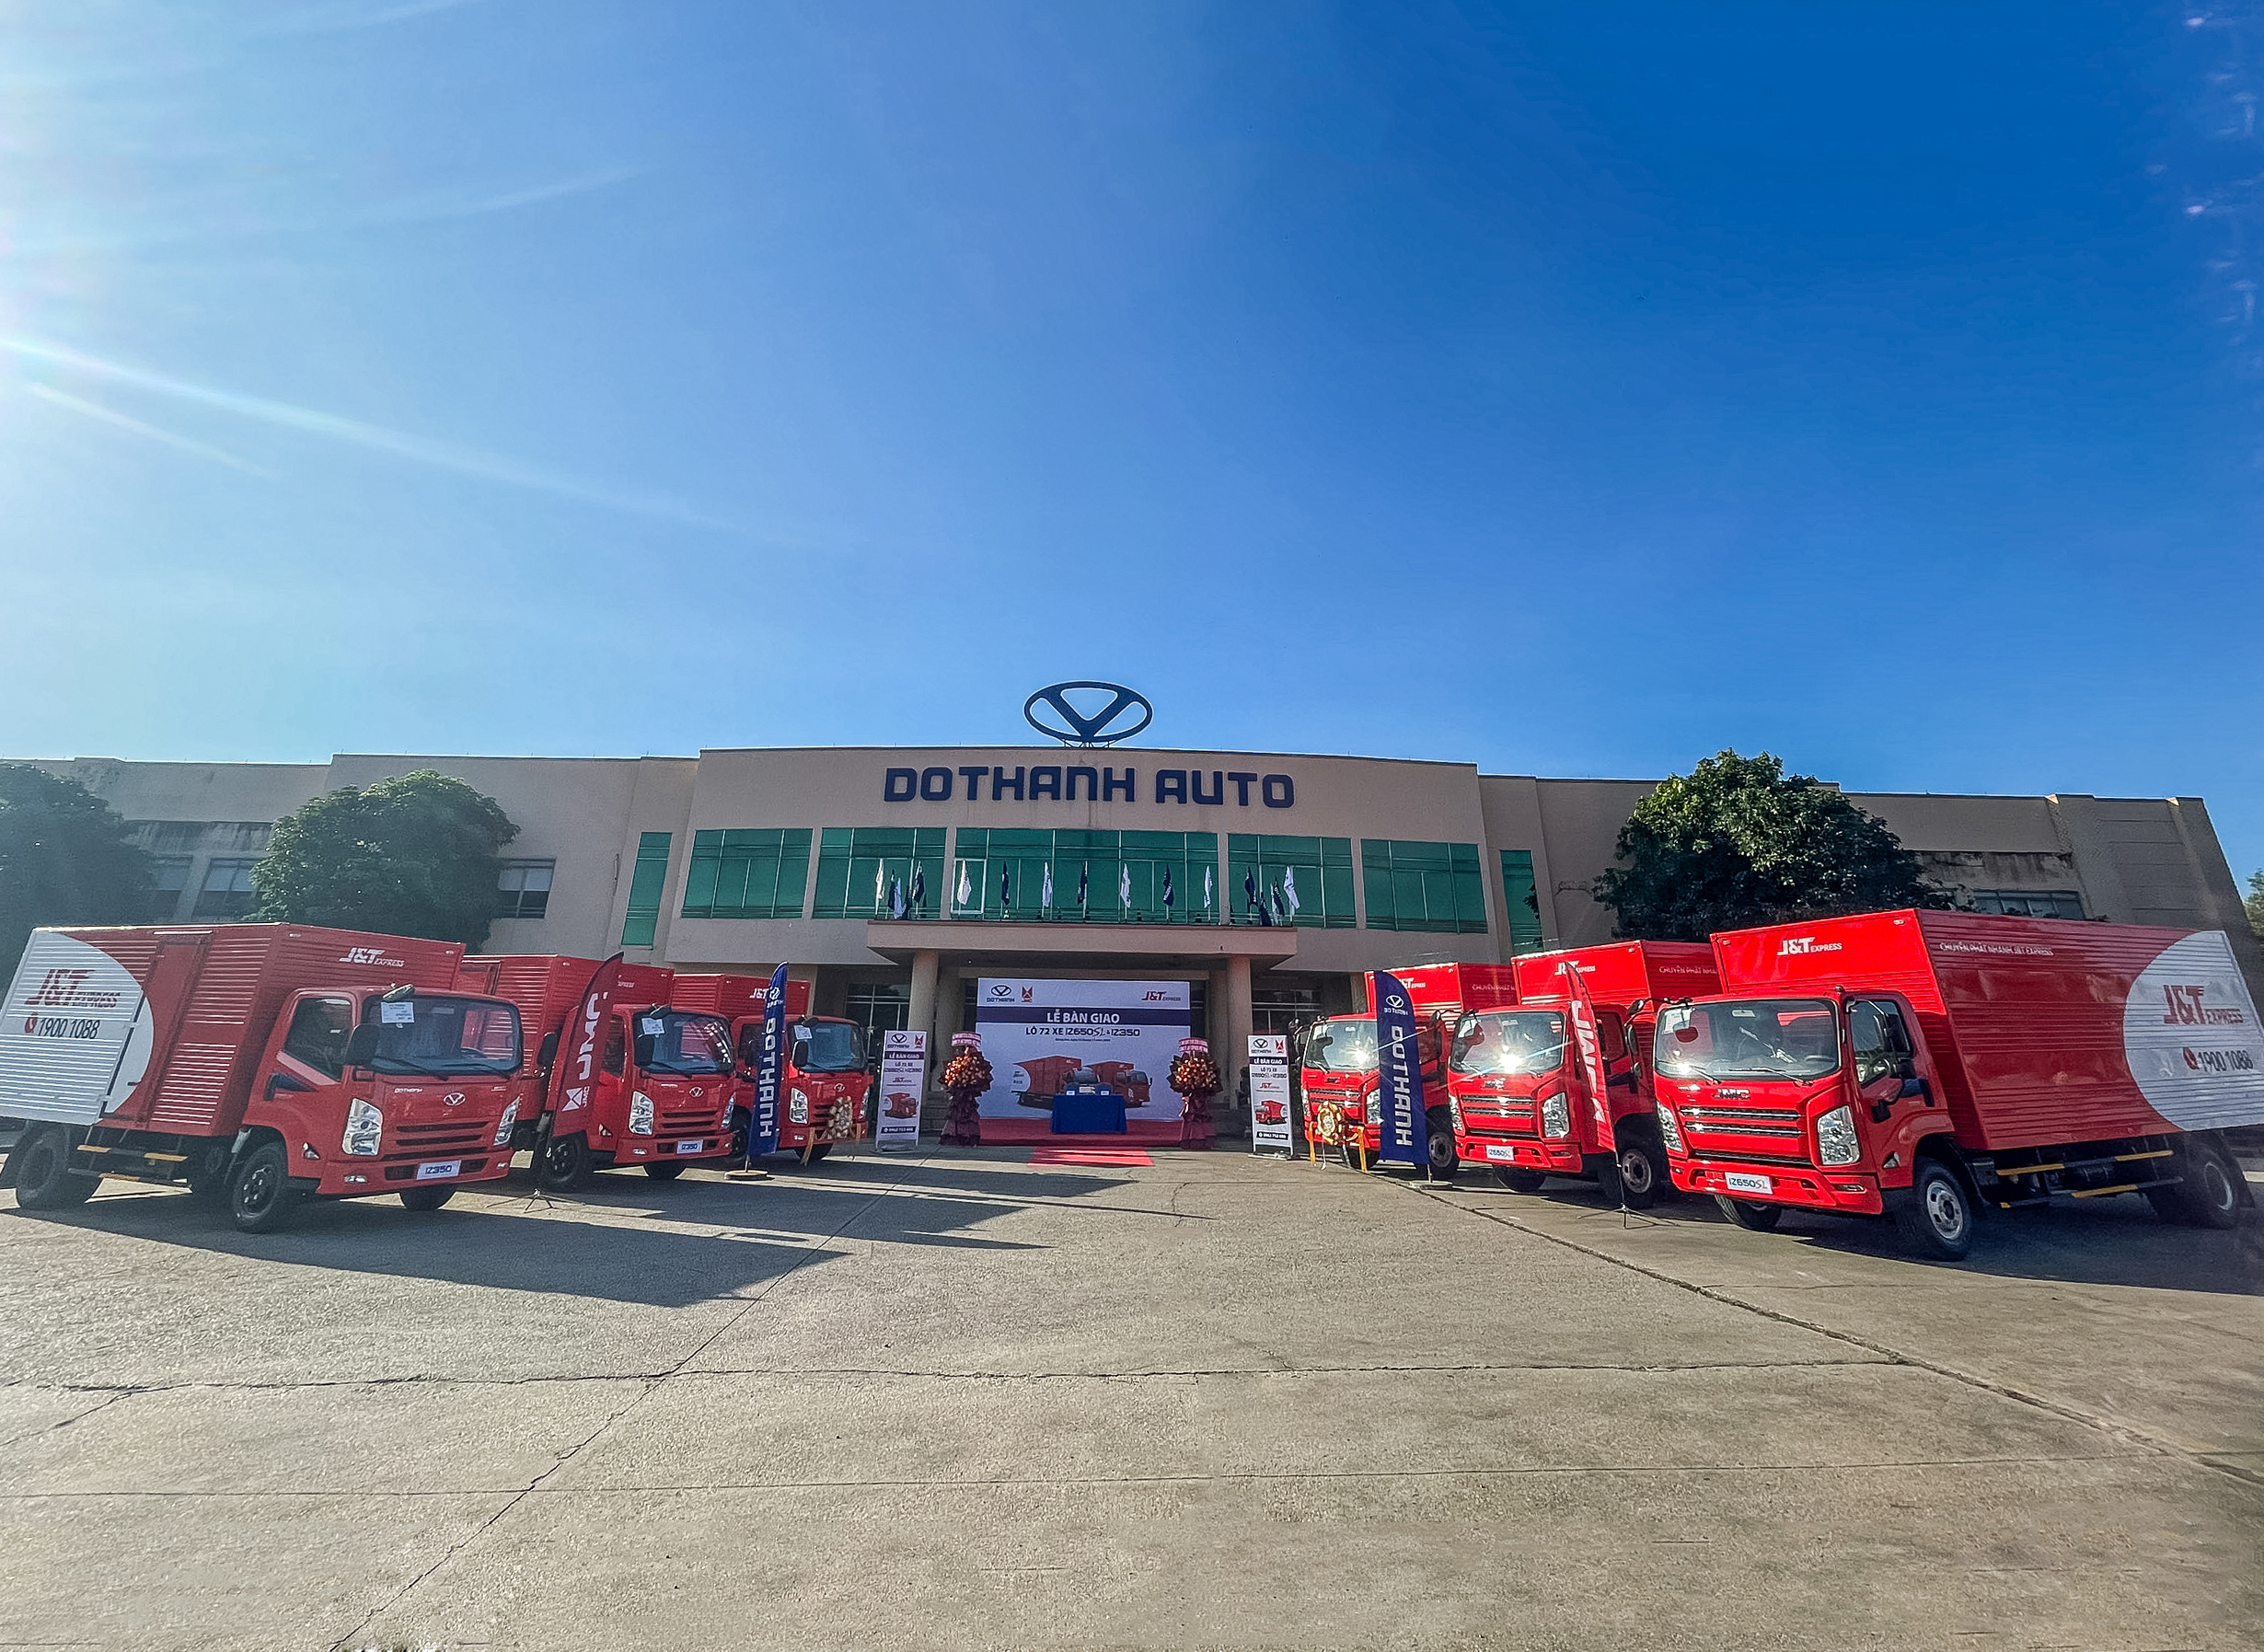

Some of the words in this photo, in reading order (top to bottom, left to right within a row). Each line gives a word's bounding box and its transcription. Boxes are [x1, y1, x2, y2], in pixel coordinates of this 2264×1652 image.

[884, 766, 1136, 803] DOTHANH
[1155, 769, 1295, 808] AUTO
[339, 947, 386, 965] J&T
[374, 958, 405, 967] EXPRESS
[1776, 937, 1815, 956] J&T
[1810, 942, 1842, 953] EXPRESS
[24, 968, 97, 1006] J&T
[71, 991, 121, 1008] EXPRESS
[1141, 991, 1167, 1001] J&T
[2163, 984, 2206, 1025] J&T
[2203, 1008, 2244, 1025] EXPRESS
[1046, 1009, 1061, 1022] LỄ
[1062, 1010, 1088, 1023] BÀN
[1090, 1012, 1121, 1024] GIAO
[38, 1017, 68, 1038] 1900
[69, 1018, 101, 1040] 1088
[1025, 1025, 1038, 1035] LÔ
[1039, 1027, 1050, 1035] 72
[1052, 1027, 1064, 1035] XE
[2197, 1051, 2226, 1072] 1900
[759, 1017, 776, 1138] DOTHANH
[1391, 1025, 1414, 1147] DOTHANH
